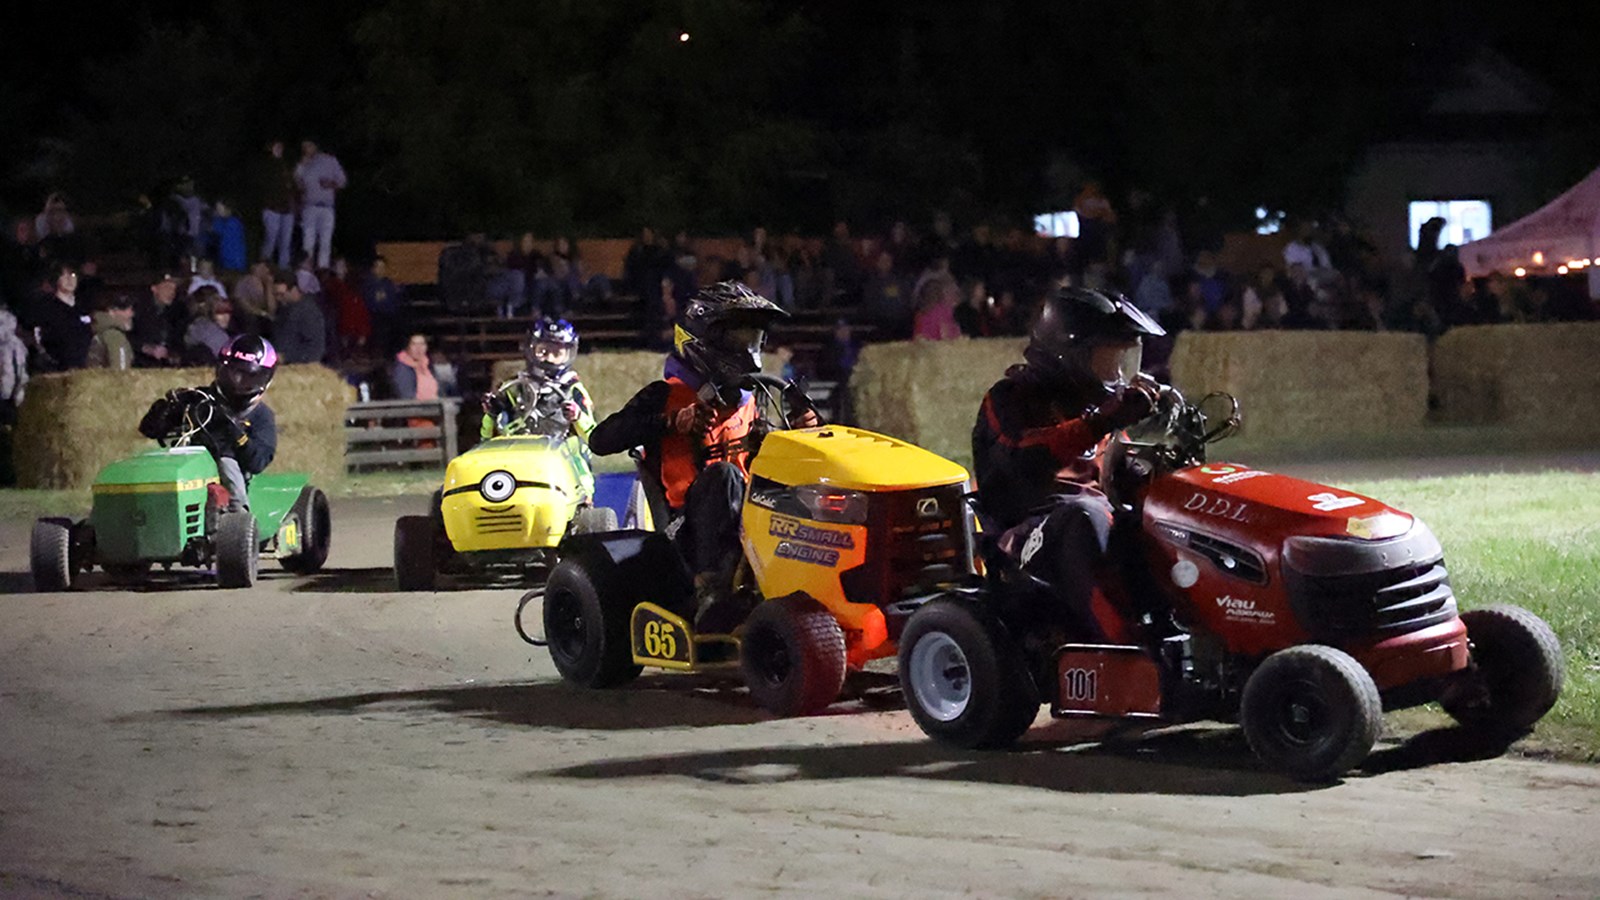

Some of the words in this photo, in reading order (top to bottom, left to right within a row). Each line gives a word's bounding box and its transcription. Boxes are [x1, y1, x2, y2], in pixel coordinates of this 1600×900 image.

[770, 516, 800, 538] RR
[799, 525, 854, 549] SMALL
[644, 620, 677, 659] 65
[1065, 668, 1097, 701] 101
